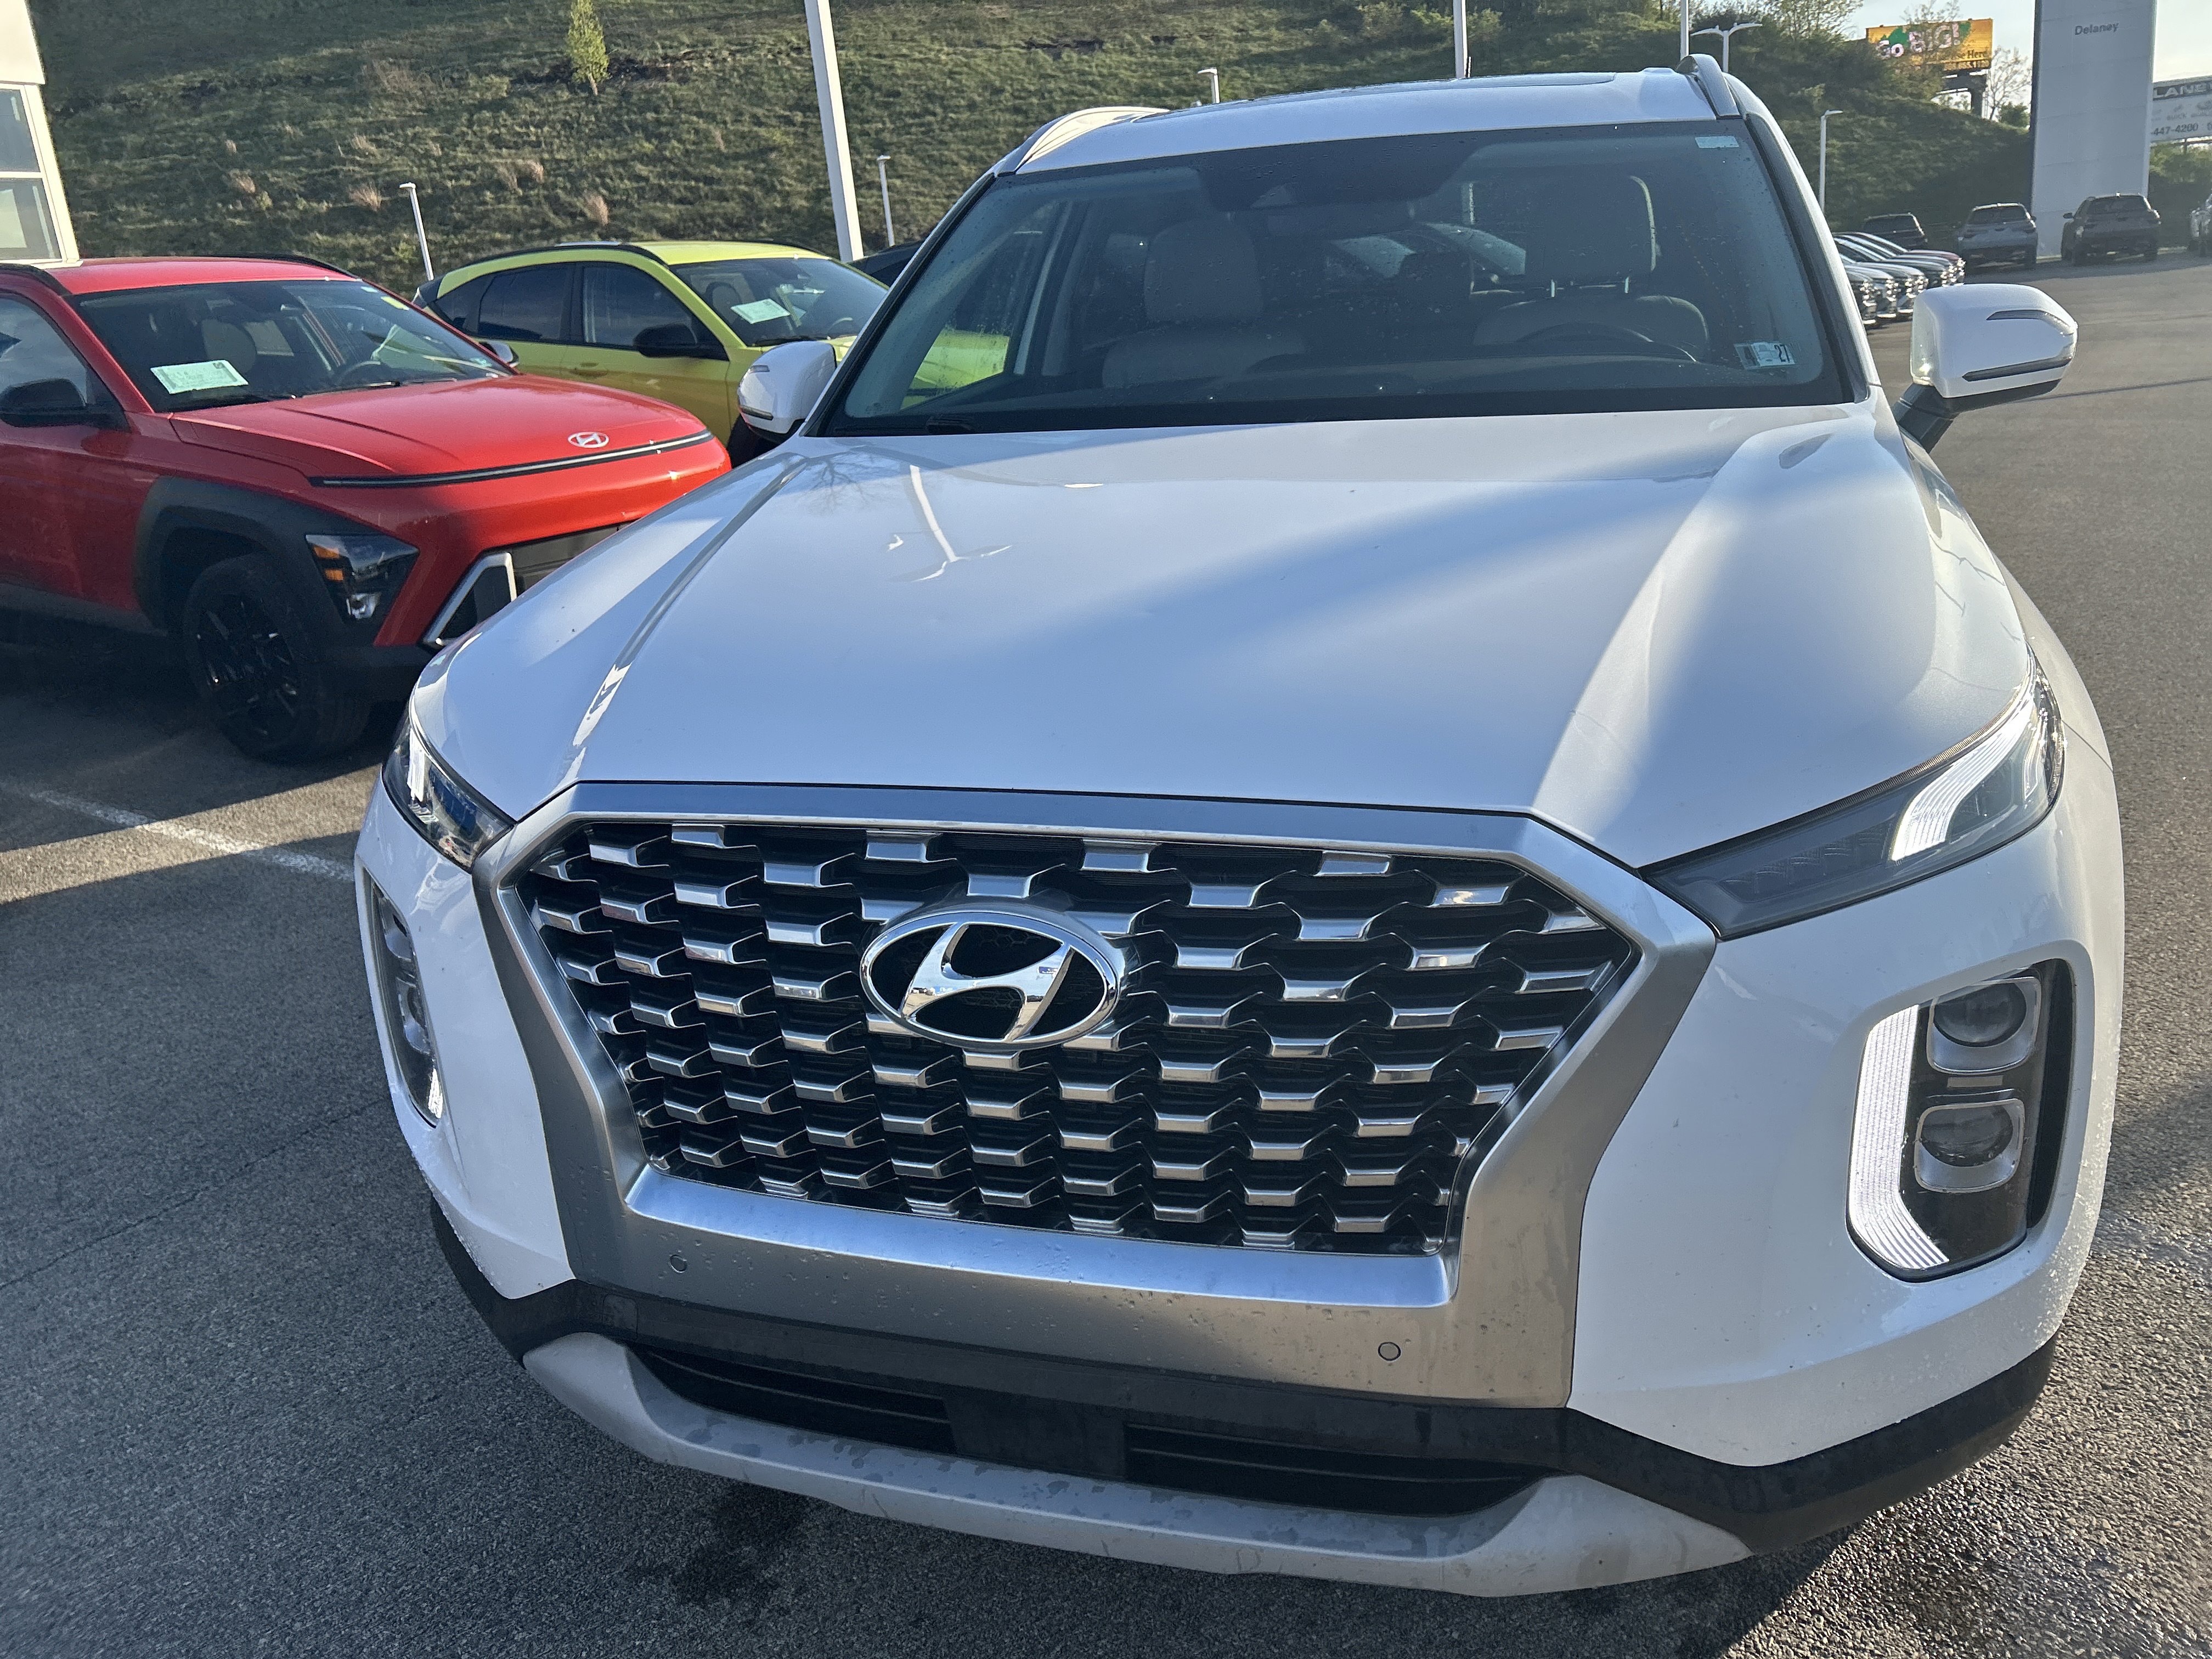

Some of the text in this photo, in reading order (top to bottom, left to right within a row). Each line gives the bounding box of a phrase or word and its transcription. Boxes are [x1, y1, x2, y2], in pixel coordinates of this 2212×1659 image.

[2074, 22, 2119, 35] Delaney
[1875, 40, 1905, 60] Go
[1908, 22, 1961, 53] BIG!
[1774, 343, 1790, 363] 27
